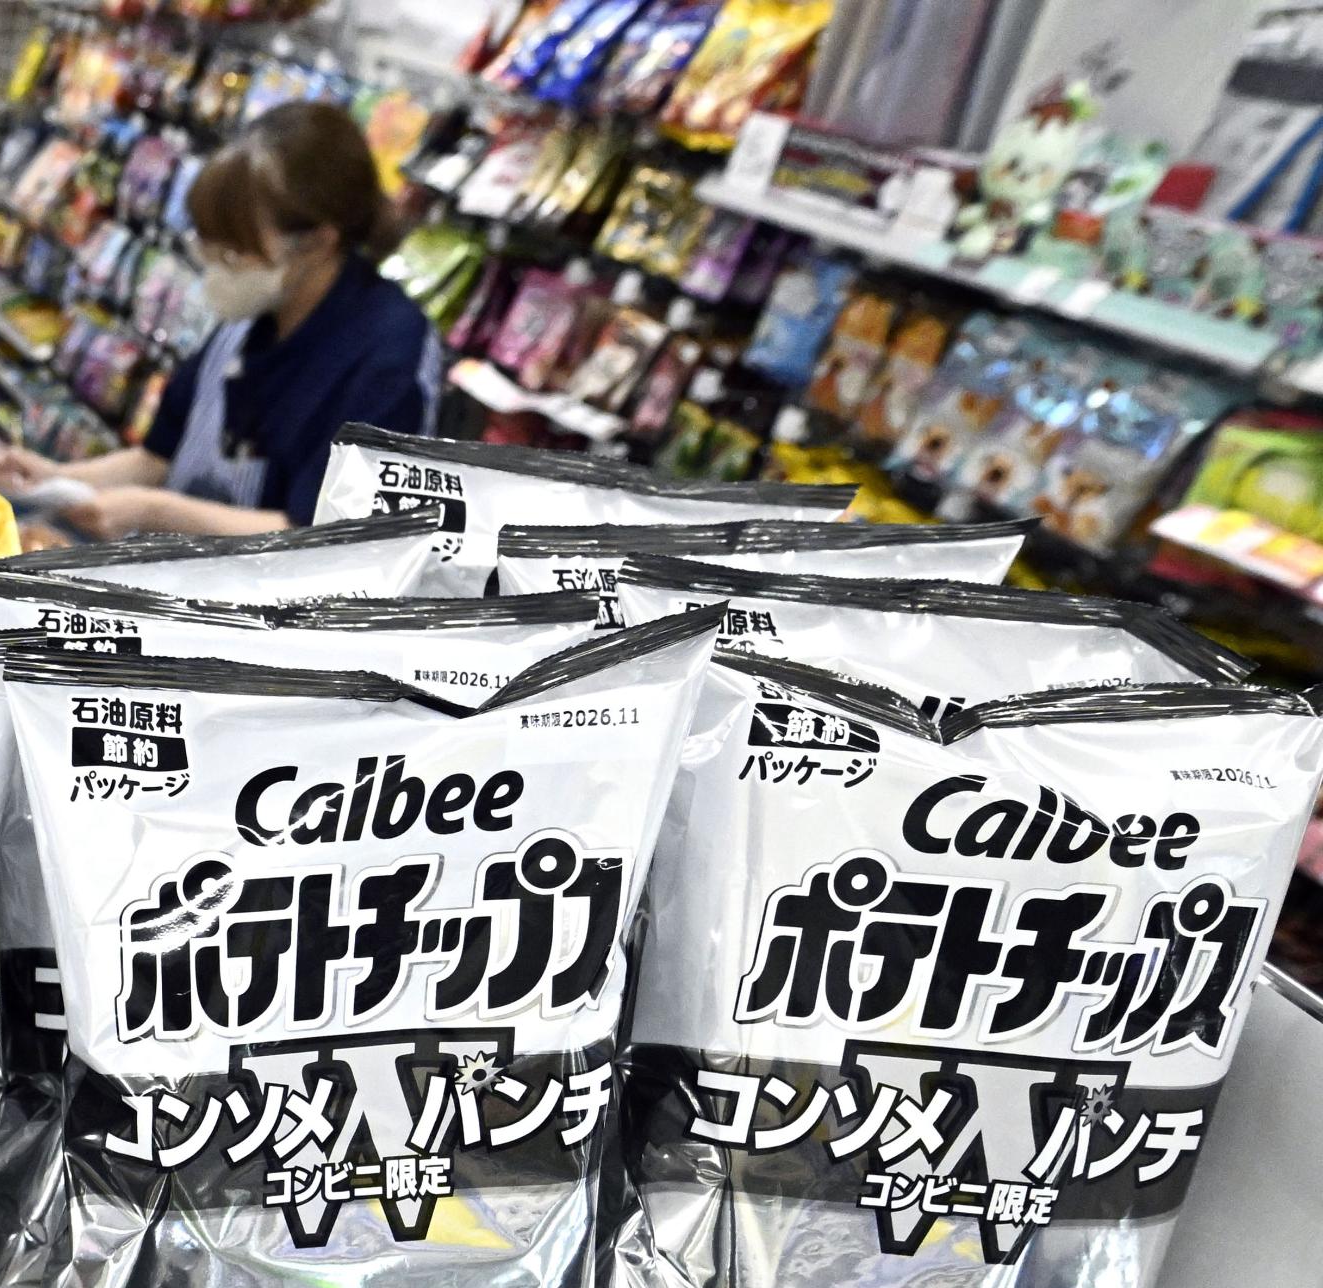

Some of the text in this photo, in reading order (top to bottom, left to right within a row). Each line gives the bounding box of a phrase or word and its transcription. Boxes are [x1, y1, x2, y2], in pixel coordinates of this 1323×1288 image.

[379, 461, 463, 497] 石油原料
[71, 696, 184, 734] 石油原料
[519, 705, 640, 733] 賞味期限2026.11
[785, 710, 851, 746] 節約
[102, 735, 159, 769] 節約
[739, 752, 878, 788] パッケージ
[70, 771, 191, 803] パッケージ
[234, 754, 526, 847] Calbee
[901, 773, 1201, 871] Calbee
[115, 829, 634, 1042] ポテトチップス
[734, 849, 1269, 1060] ポテトチップス
[263, 1155, 453, 1208] コンビニ限定
[860, 1173, 1059, 1225] コンビニ限定
